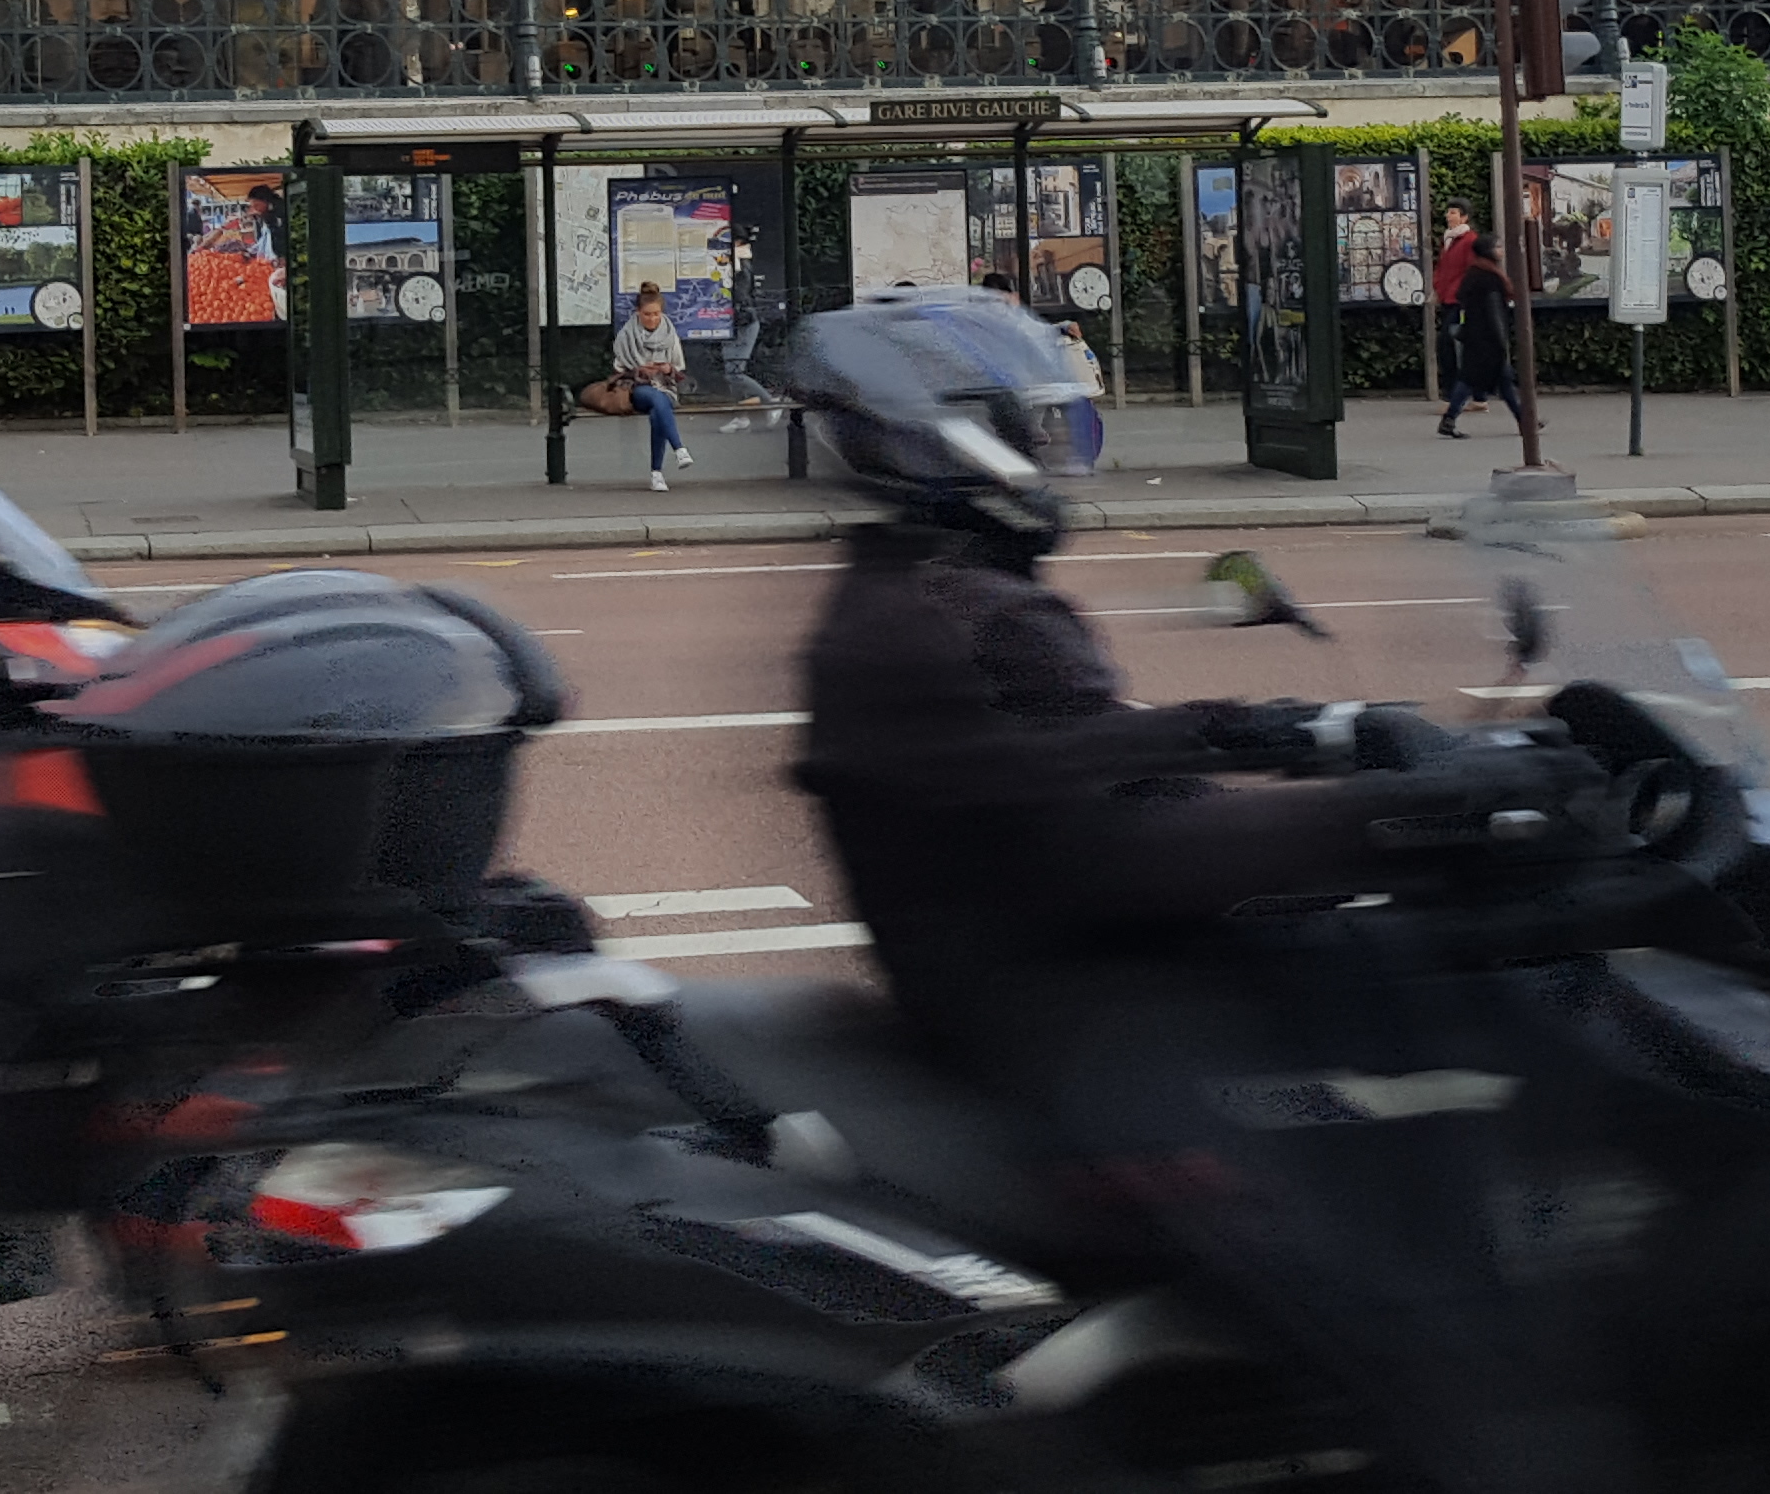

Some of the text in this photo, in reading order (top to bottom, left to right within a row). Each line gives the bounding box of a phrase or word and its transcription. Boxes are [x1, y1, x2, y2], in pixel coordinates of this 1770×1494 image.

[878, 99, 1051, 120] GARE RIVE GAUCHE
